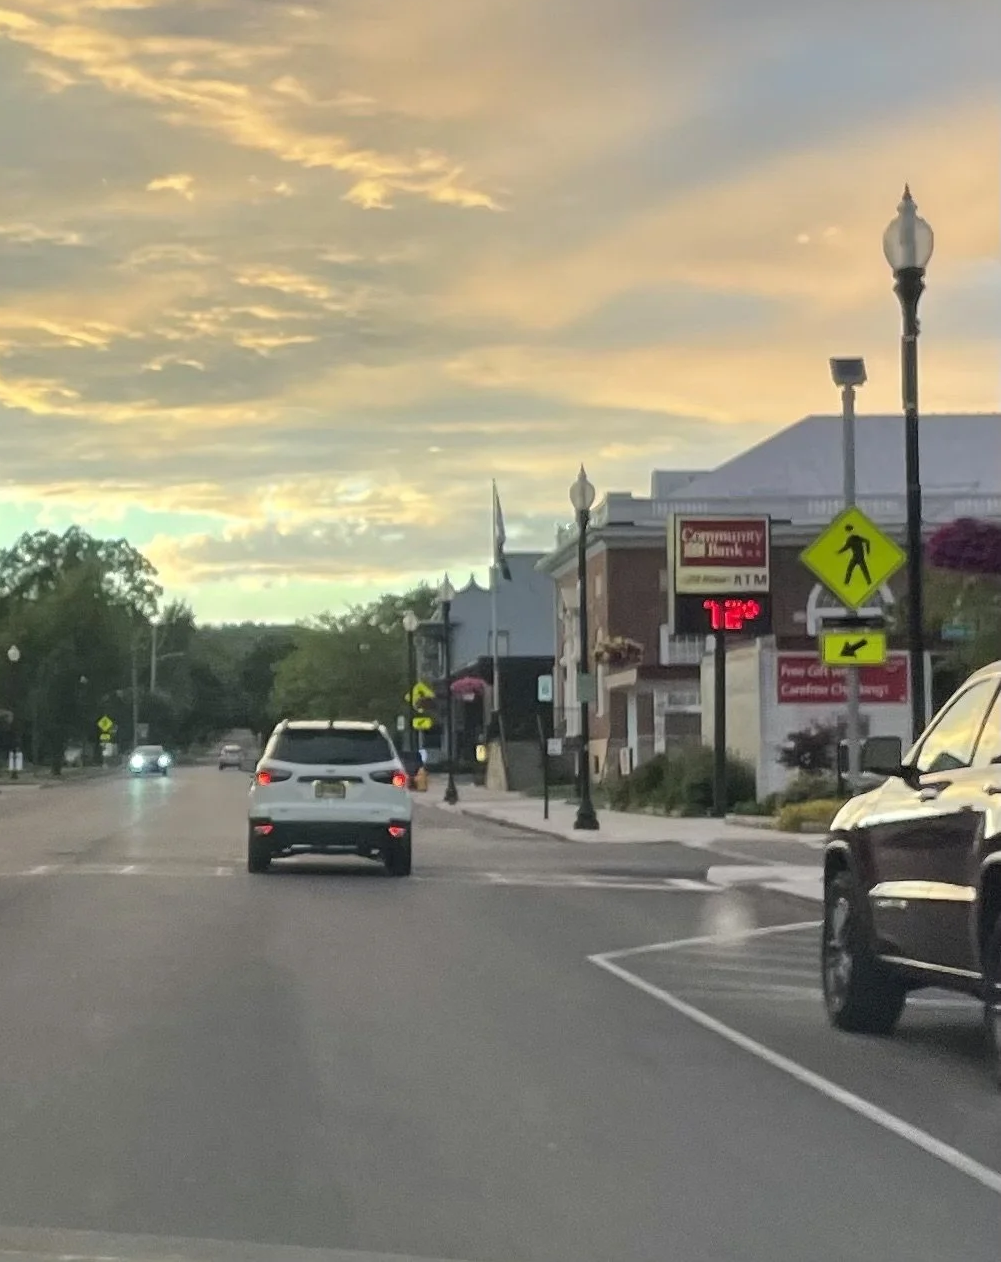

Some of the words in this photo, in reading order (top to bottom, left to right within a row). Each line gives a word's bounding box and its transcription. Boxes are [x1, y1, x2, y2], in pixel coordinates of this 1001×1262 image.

[682, 528, 762, 545] Community
[708, 542, 743, 557] Bank
[733, 574, 767, 586] ATM
